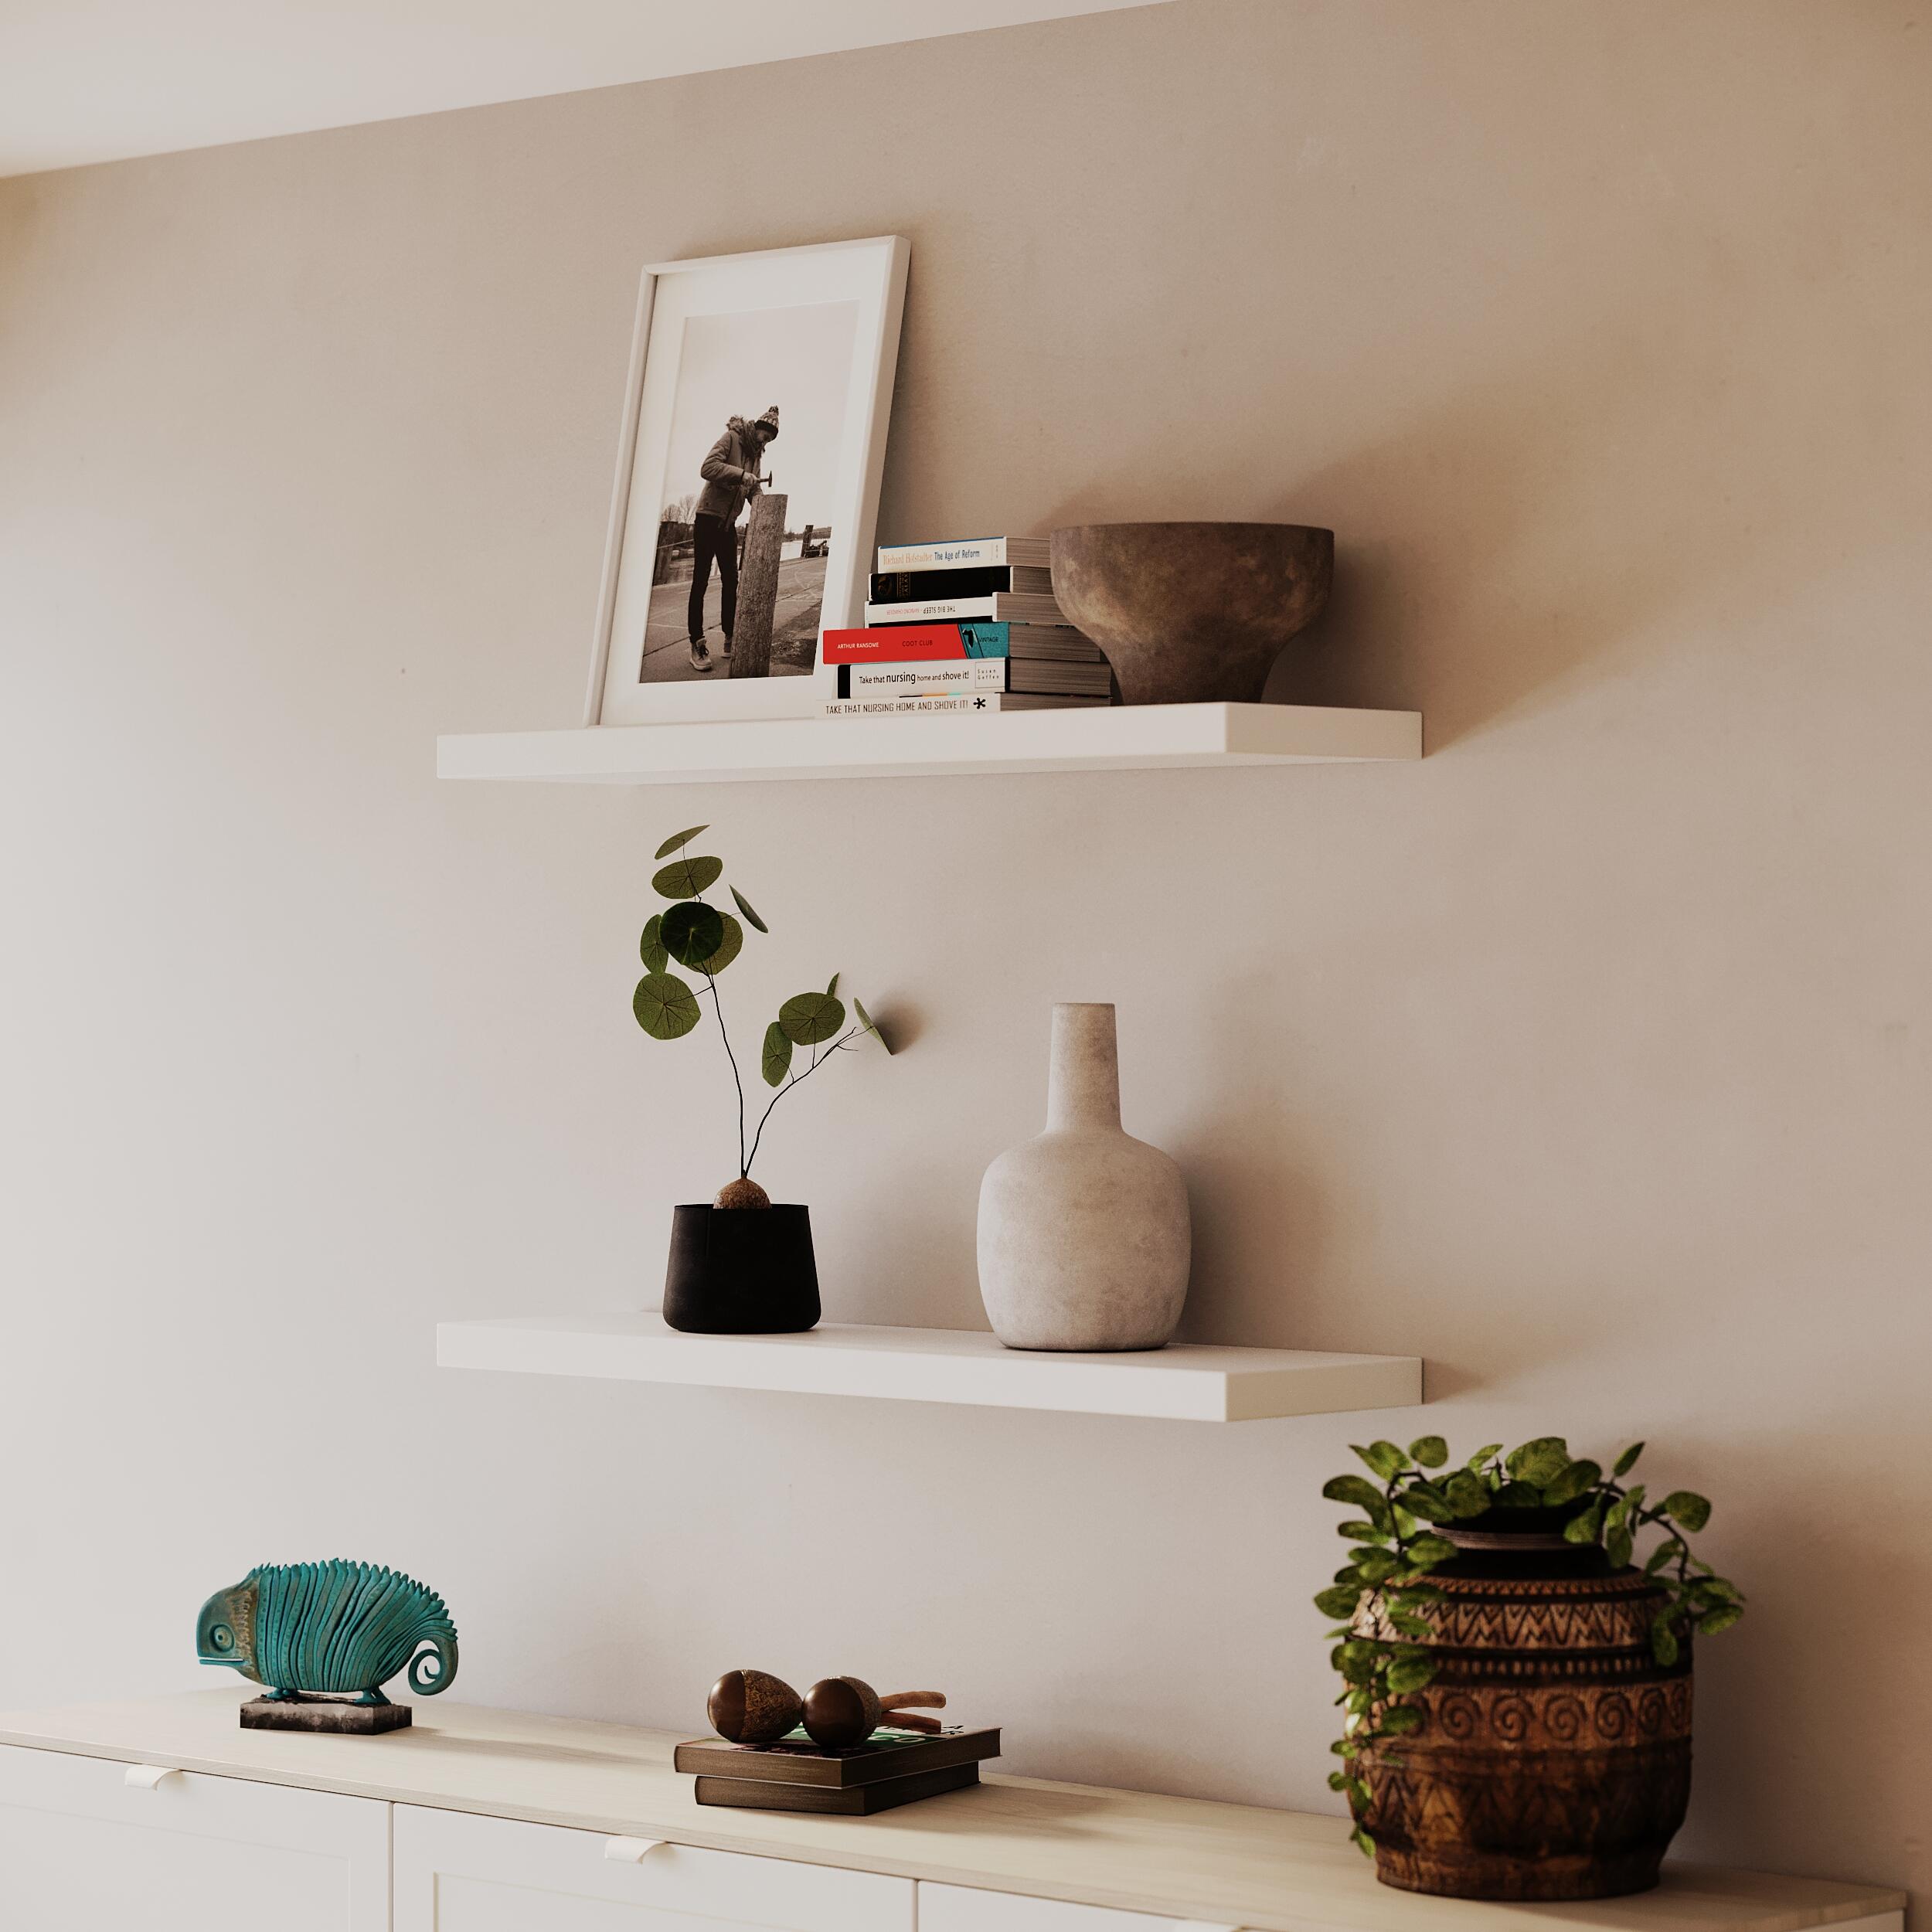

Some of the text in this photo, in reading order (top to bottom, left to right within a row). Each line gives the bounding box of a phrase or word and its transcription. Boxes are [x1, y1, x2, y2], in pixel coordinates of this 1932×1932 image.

[883, 554, 904, 565] Richard
[934, 552, 942, 560] The
[945, 551, 953, 561] Age
[955, 551, 960, 559] of
[962, 549, 980, 558] Reform
[886, 672, 915, 684] nursing
[942, 672, 961, 680] shove
[826, 699, 968, 714] TAKE THAT NURSING HOME AND SHOVE IT!
